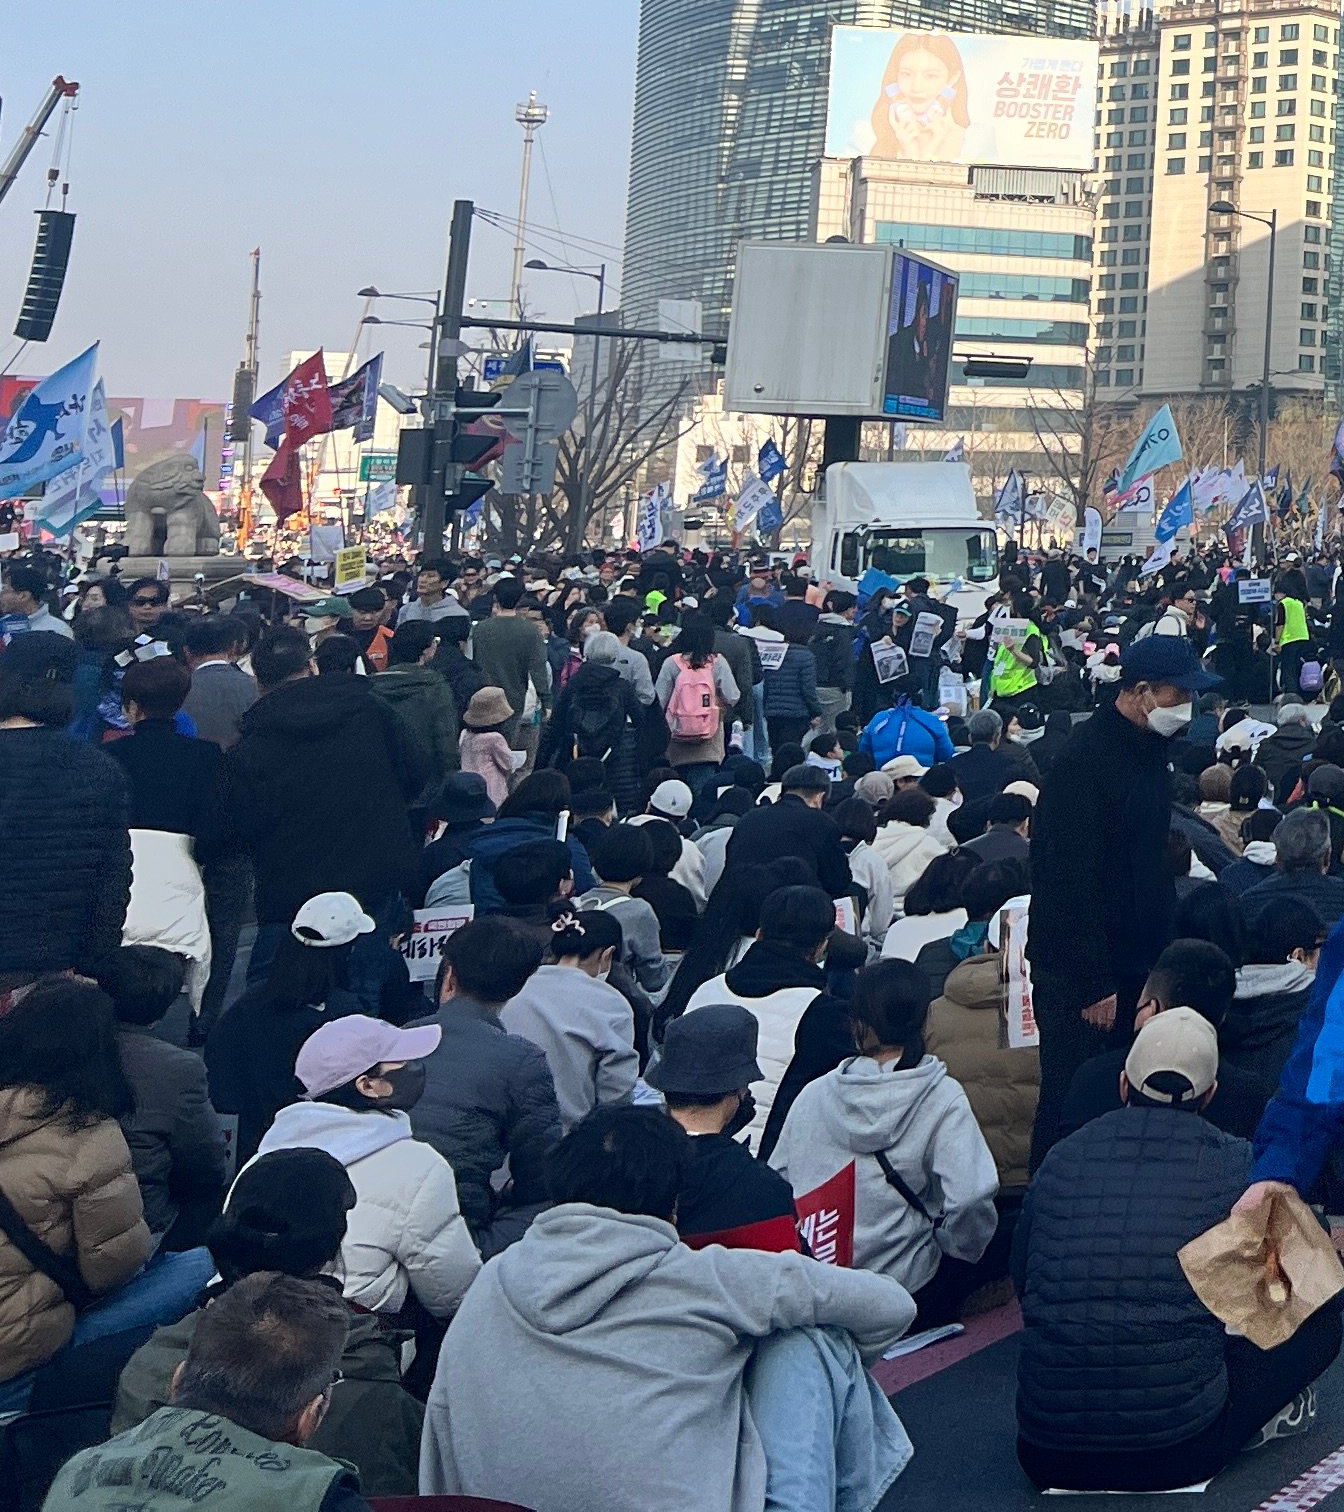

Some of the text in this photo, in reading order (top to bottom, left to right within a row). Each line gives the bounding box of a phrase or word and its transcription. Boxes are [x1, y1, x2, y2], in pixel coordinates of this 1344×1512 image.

[995, 71, 1082, 101] 상쾌환
[993, 101, 1075, 121] BOOSTER
[1024, 121, 1071, 139] ZERO
